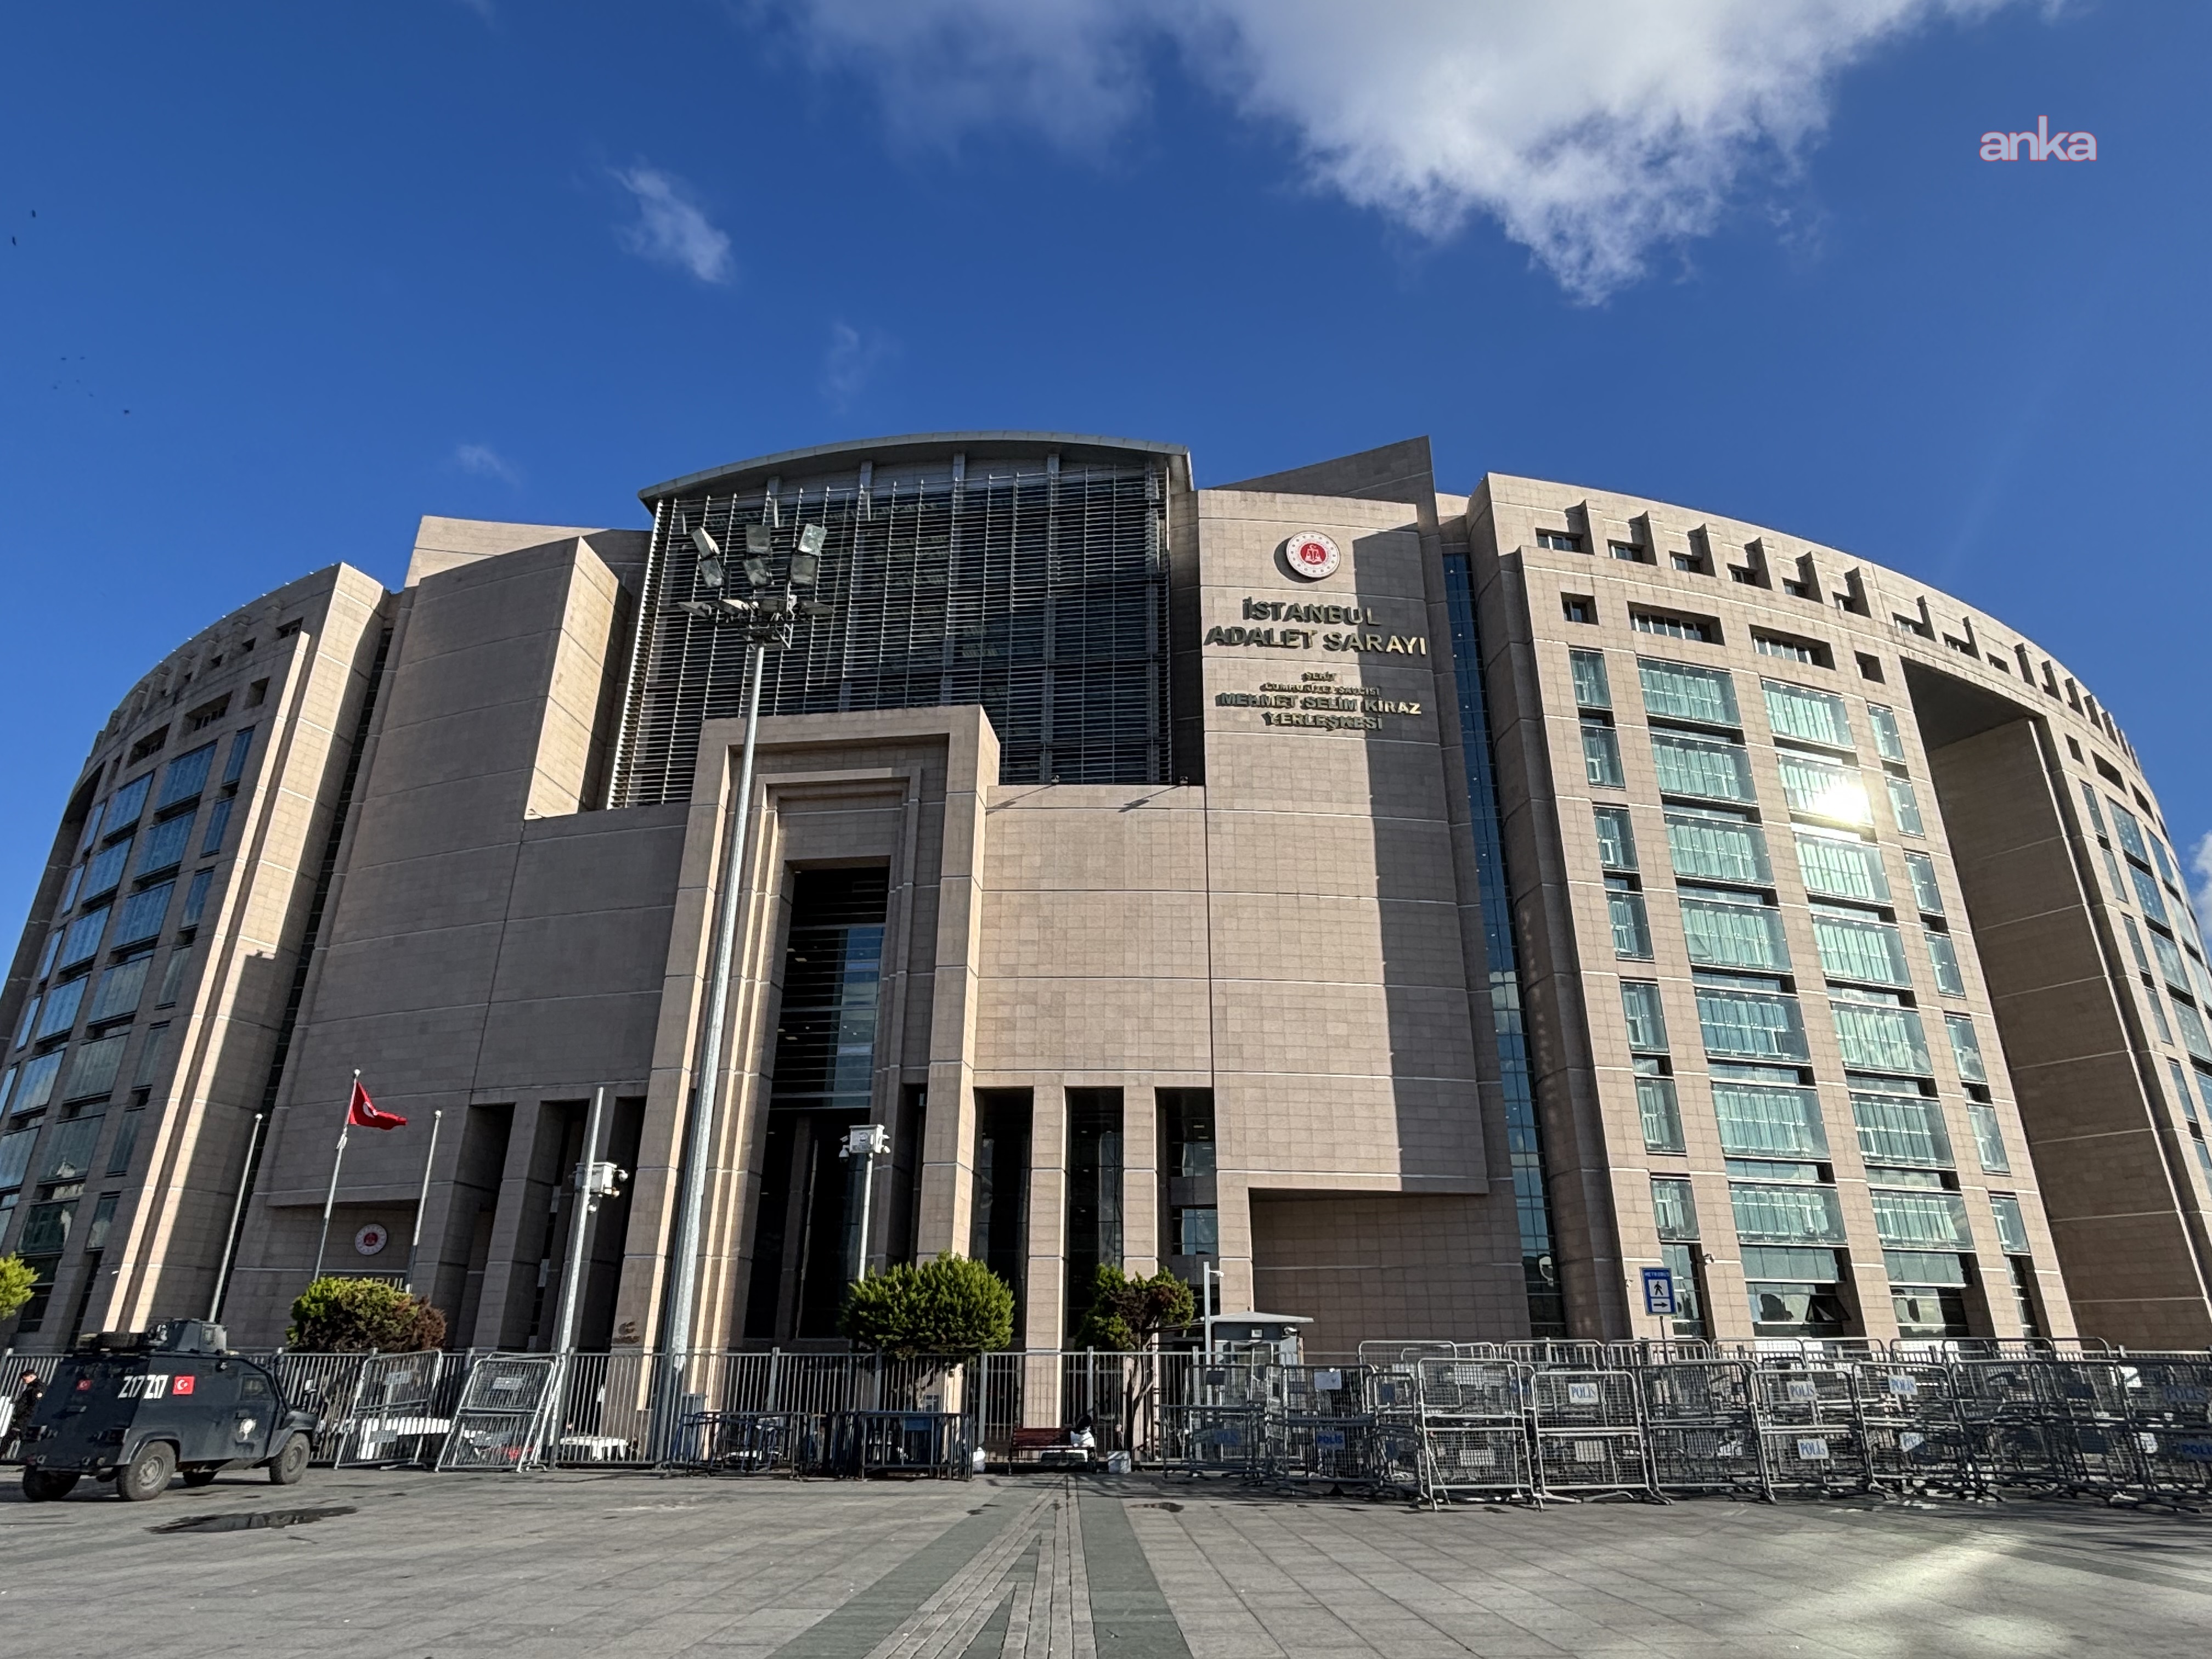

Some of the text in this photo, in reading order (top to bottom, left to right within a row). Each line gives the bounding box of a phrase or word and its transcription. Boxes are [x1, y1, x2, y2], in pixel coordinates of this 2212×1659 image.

[1243, 596, 1382, 626] İSTANBUL
[1204, 625, 1426, 656] ADALET SARAYI
[1216, 693, 1422, 714] MEHMET SELİM KİRAZ
[1262, 712, 1383, 731] YERLEŞKESİ
[1571, 1385, 1596, 1398] POLİS
[1790, 1383, 1815, 1397] POLİS
[1317, 1434, 1343, 1444] POLİS
[2181, 1443, 2212, 1455] POLİ
